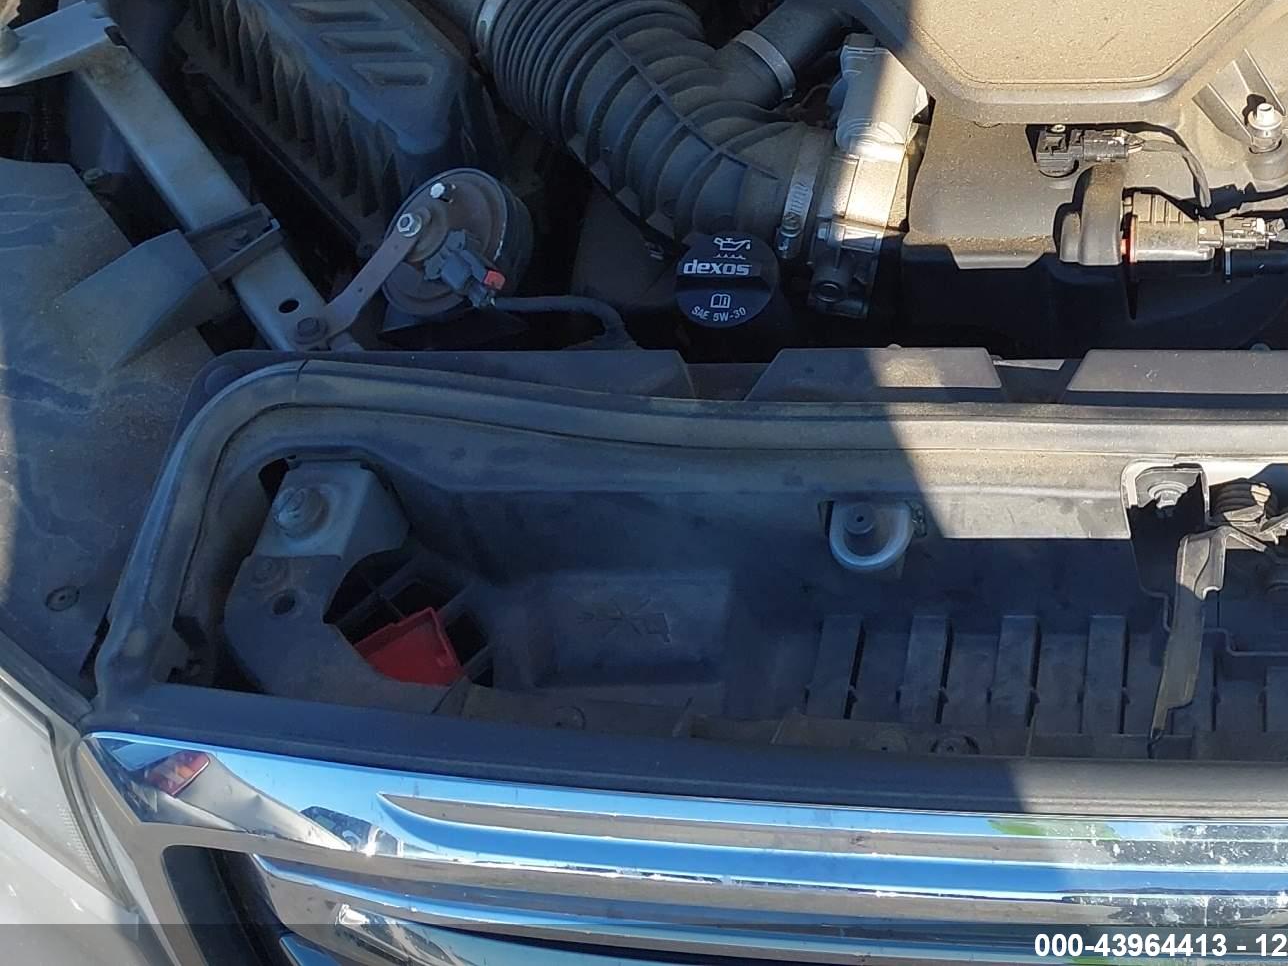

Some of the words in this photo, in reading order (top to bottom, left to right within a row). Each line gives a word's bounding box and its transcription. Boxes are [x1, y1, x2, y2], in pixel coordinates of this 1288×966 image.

[683, 259, 752, 275] dexos
[691, 306, 710, 320] SAE
[713, 307, 746, 322] 5W-30
